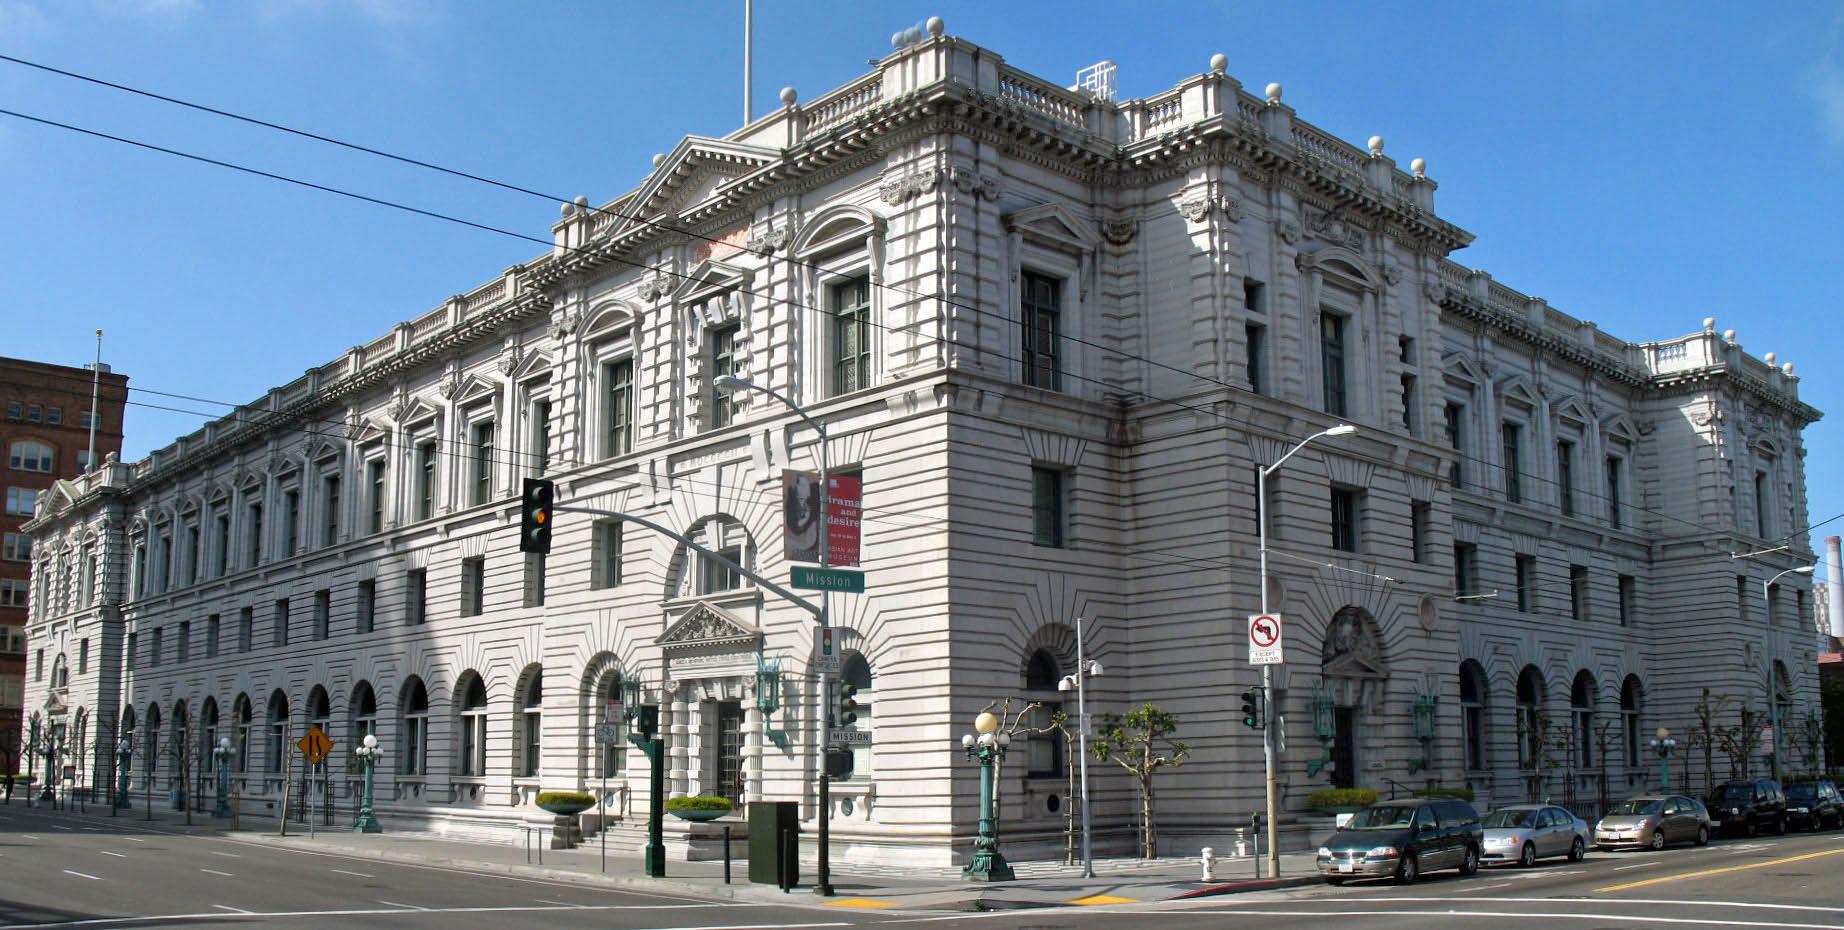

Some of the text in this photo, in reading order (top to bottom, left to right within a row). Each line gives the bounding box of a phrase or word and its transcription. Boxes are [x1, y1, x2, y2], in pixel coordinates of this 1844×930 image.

[840, 509, 856, 517] and
[827, 515, 859, 527] desire
[806, 572, 850, 587] Mission
[833, 732, 868, 741] MISSION
